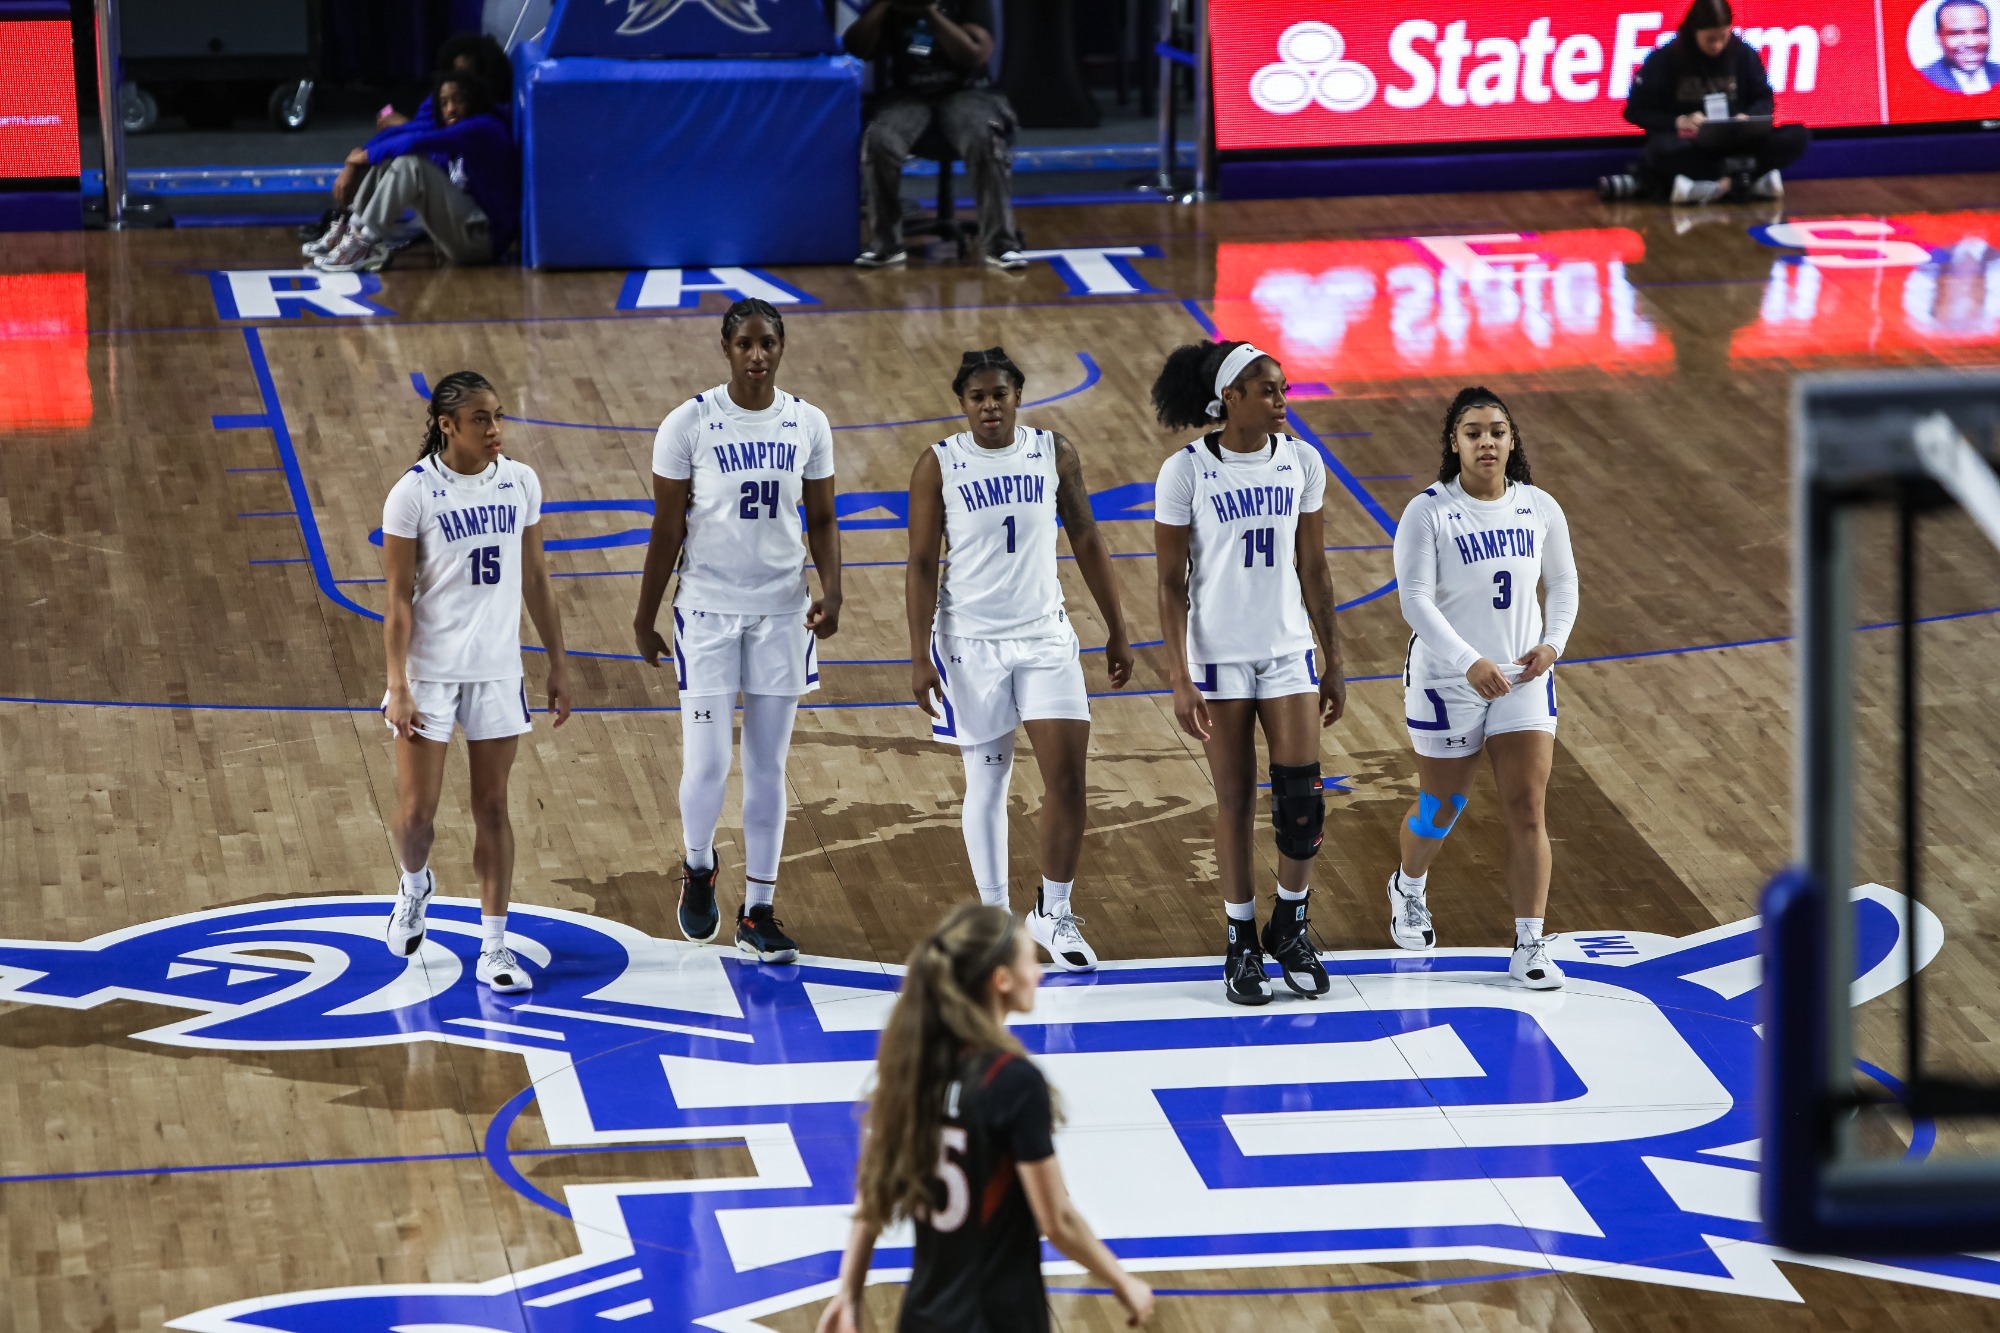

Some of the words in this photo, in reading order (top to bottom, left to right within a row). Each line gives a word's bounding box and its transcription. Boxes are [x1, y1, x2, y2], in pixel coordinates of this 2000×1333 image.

[1383, 17, 1604, 109] State
[1607, 12, 1819, 99] Fm
[781, 420, 798, 428] CAA
[713, 441, 798, 474] HAMPTON
[1026, 451, 1043, 459] CAA
[1275, 464, 1293, 472] CAA
[497, 481, 514, 490] CAA
[739, 479, 780, 520] 24
[957, 474, 1045, 513] HAMPTON
[1209, 485, 1295, 523] HAMPTON
[436, 504, 518, 543] HAMPTON
[1516, 507, 1532, 515] CAA
[1001, 515, 1016, 554] 1
[1240, 527, 1275, 569] 14
[1453, 527, 1536, 566] HAMPTON
[467, 544, 501, 585] 15
[1492, 570, 1512, 610] 3
[1573, 935, 1640, 959] TM
